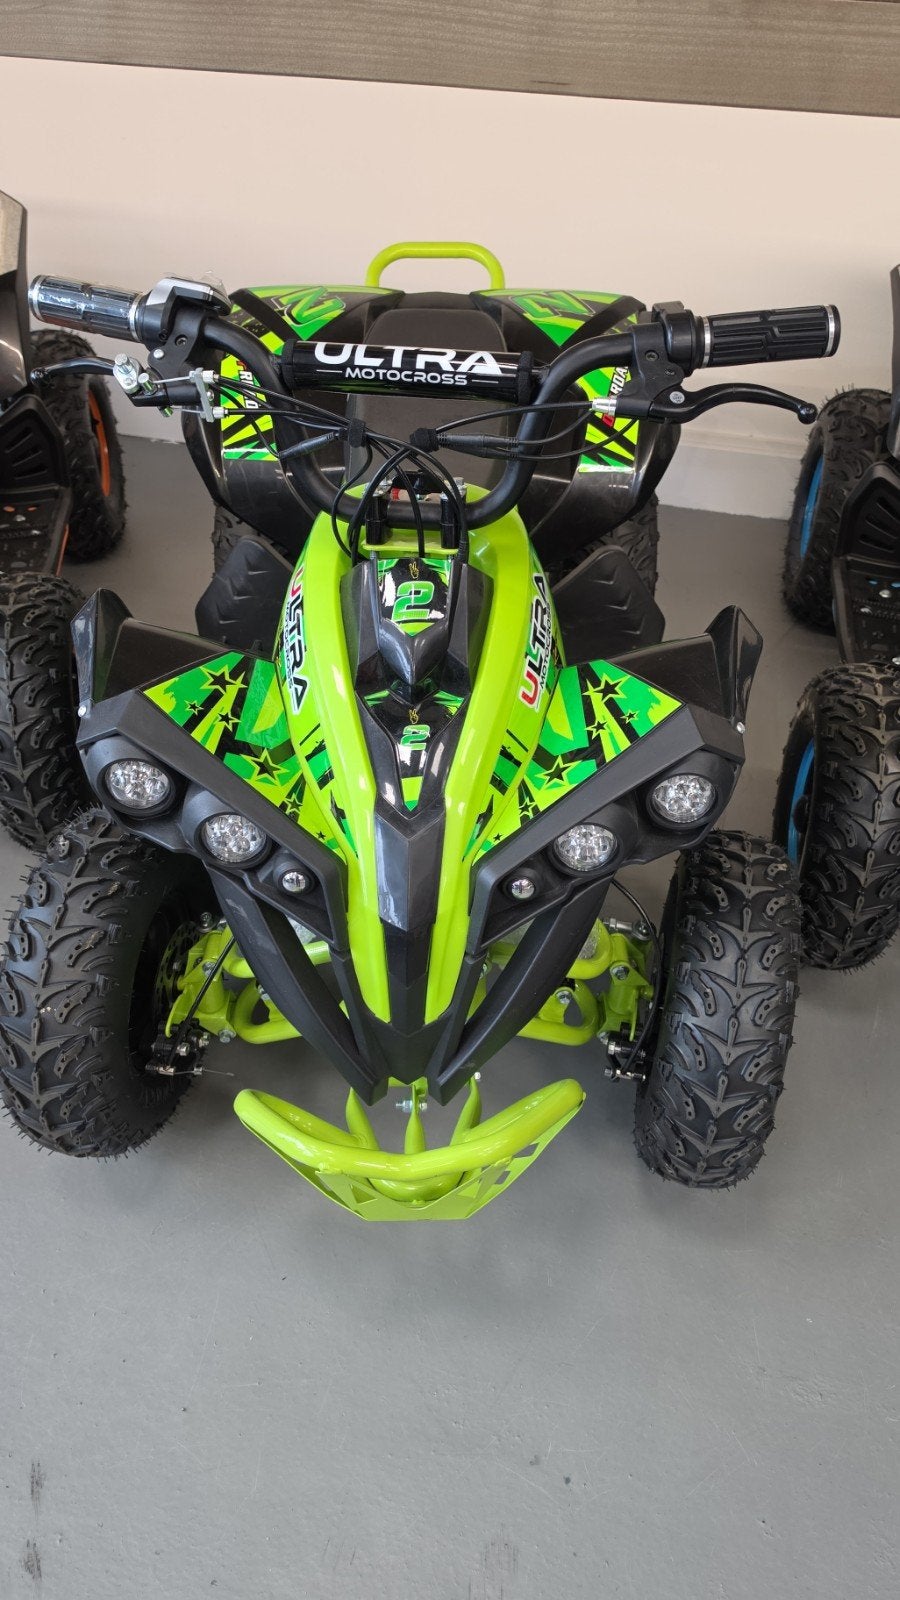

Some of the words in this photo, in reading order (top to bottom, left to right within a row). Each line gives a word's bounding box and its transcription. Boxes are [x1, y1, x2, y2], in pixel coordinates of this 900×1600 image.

[314, 342, 502, 374] ULTRA
[345, 367, 468, 387] MOTOCROSS
[391, 580, 435, 622] 2
[289, 567, 309, 711] ULTRA
[520, 574, 548, 706] ULTRA
[400, 724, 431, 751] 2
